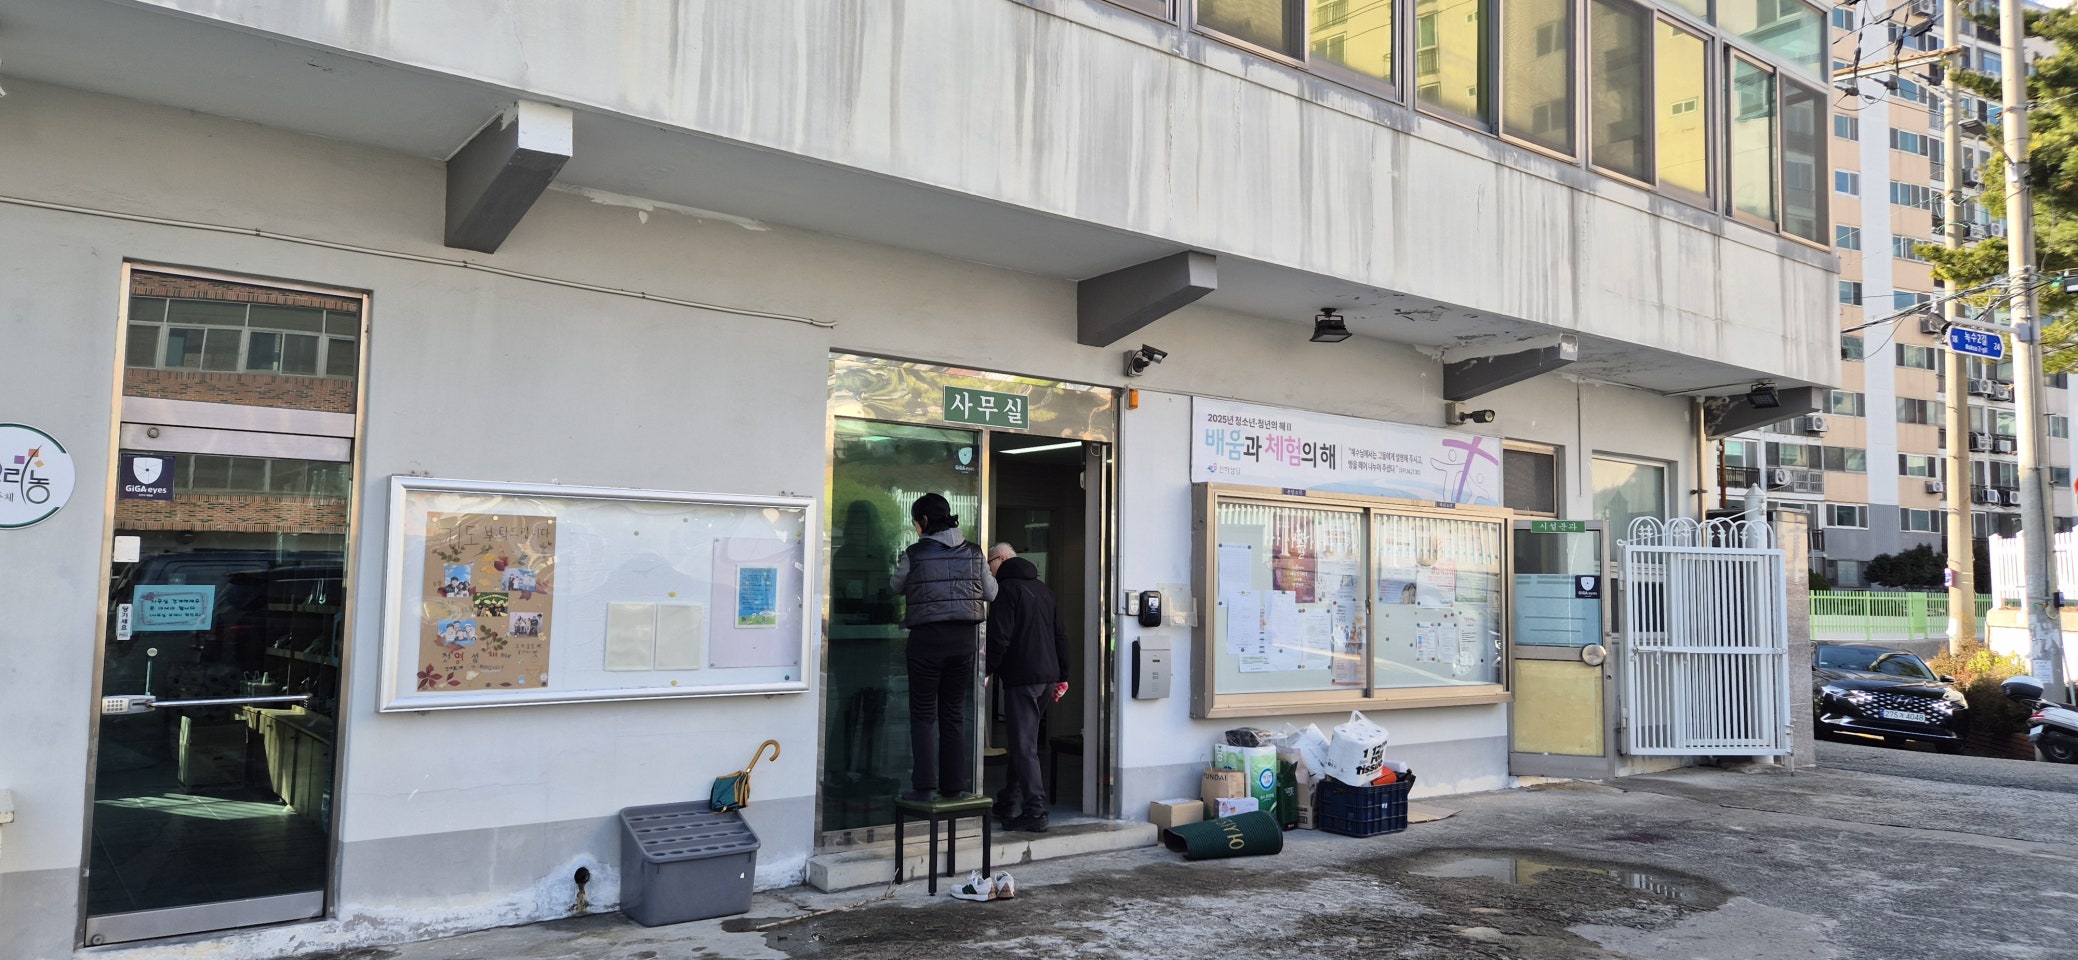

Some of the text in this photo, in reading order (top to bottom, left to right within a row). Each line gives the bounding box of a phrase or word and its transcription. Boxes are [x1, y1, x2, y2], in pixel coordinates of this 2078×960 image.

[1964, 331, 1988, 346] 녹수2길
[950, 391, 1024, 424] 사무실
[1207, 413, 1234, 426] 2025년
[1205, 428, 1336, 470] 배움과 체험의 해
[440, 525, 551, 549] 기도 부탁드립니다
[121, 606, 129, 631] 당기세요
